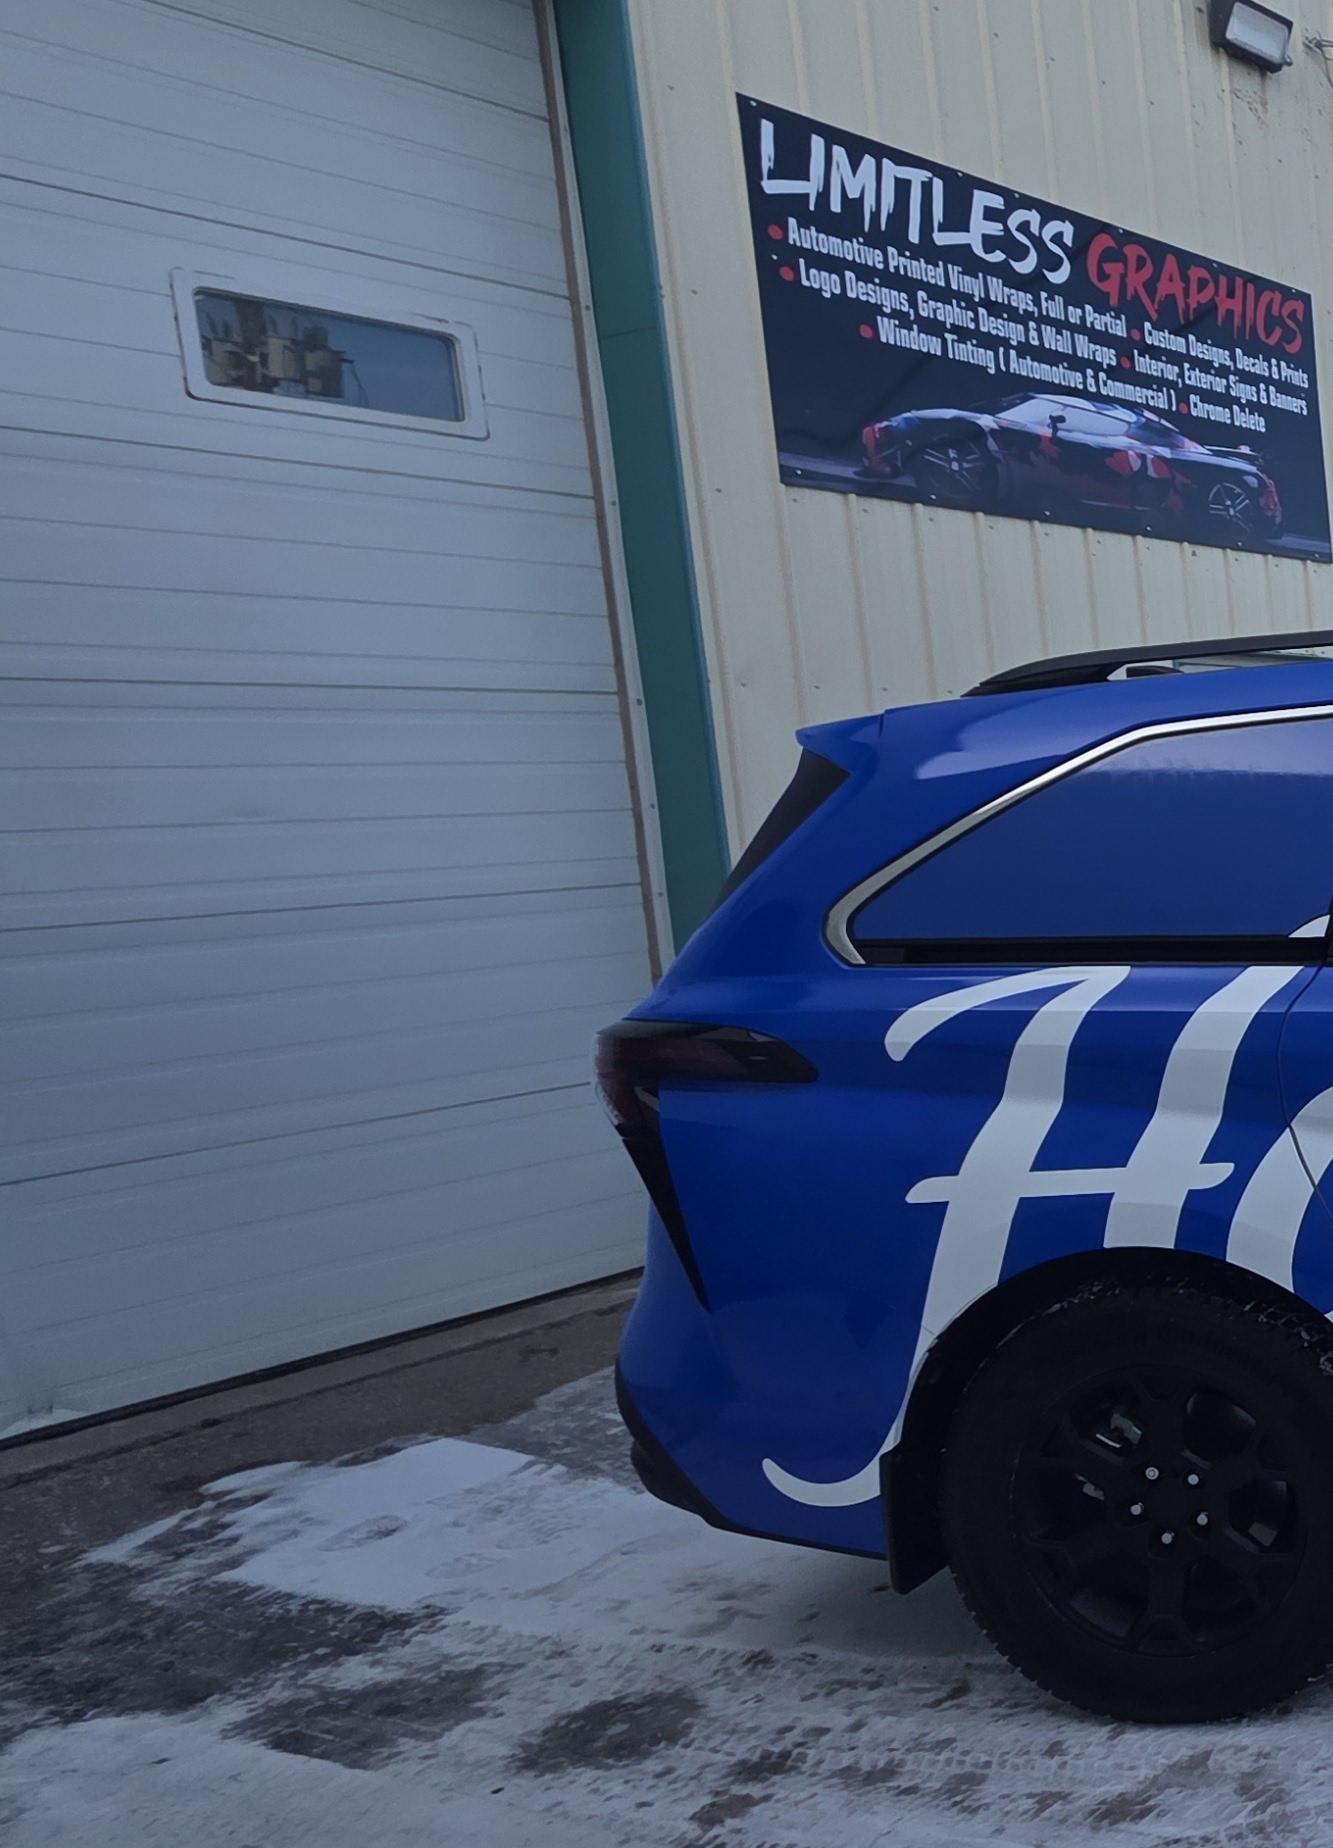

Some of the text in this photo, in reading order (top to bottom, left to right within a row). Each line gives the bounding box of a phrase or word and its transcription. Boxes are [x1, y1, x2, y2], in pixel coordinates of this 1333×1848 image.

[761, 118, 1305, 354] LIMITLESS GRAPHICS
[787, 216, 1308, 389] Automotive Printed Vinyl Wraps, Full or Partial Custom Designs, Decals & Prints
[798, 257, 1308, 416] Logo Designs, Graphic Design & Wall Wraps Interior, Exterior Signs & Banners
[876, 315, 942, 357] Window
[944, 332, 995, 375] Tinting
[1009, 348, 1084, 390] Automotive
[1086, 367, 1097, 393] &
[1098, 370, 1168, 410] Commercial
[1189, 393, 1232, 425] Chrome
[1232, 403, 1266, 433] Delete
